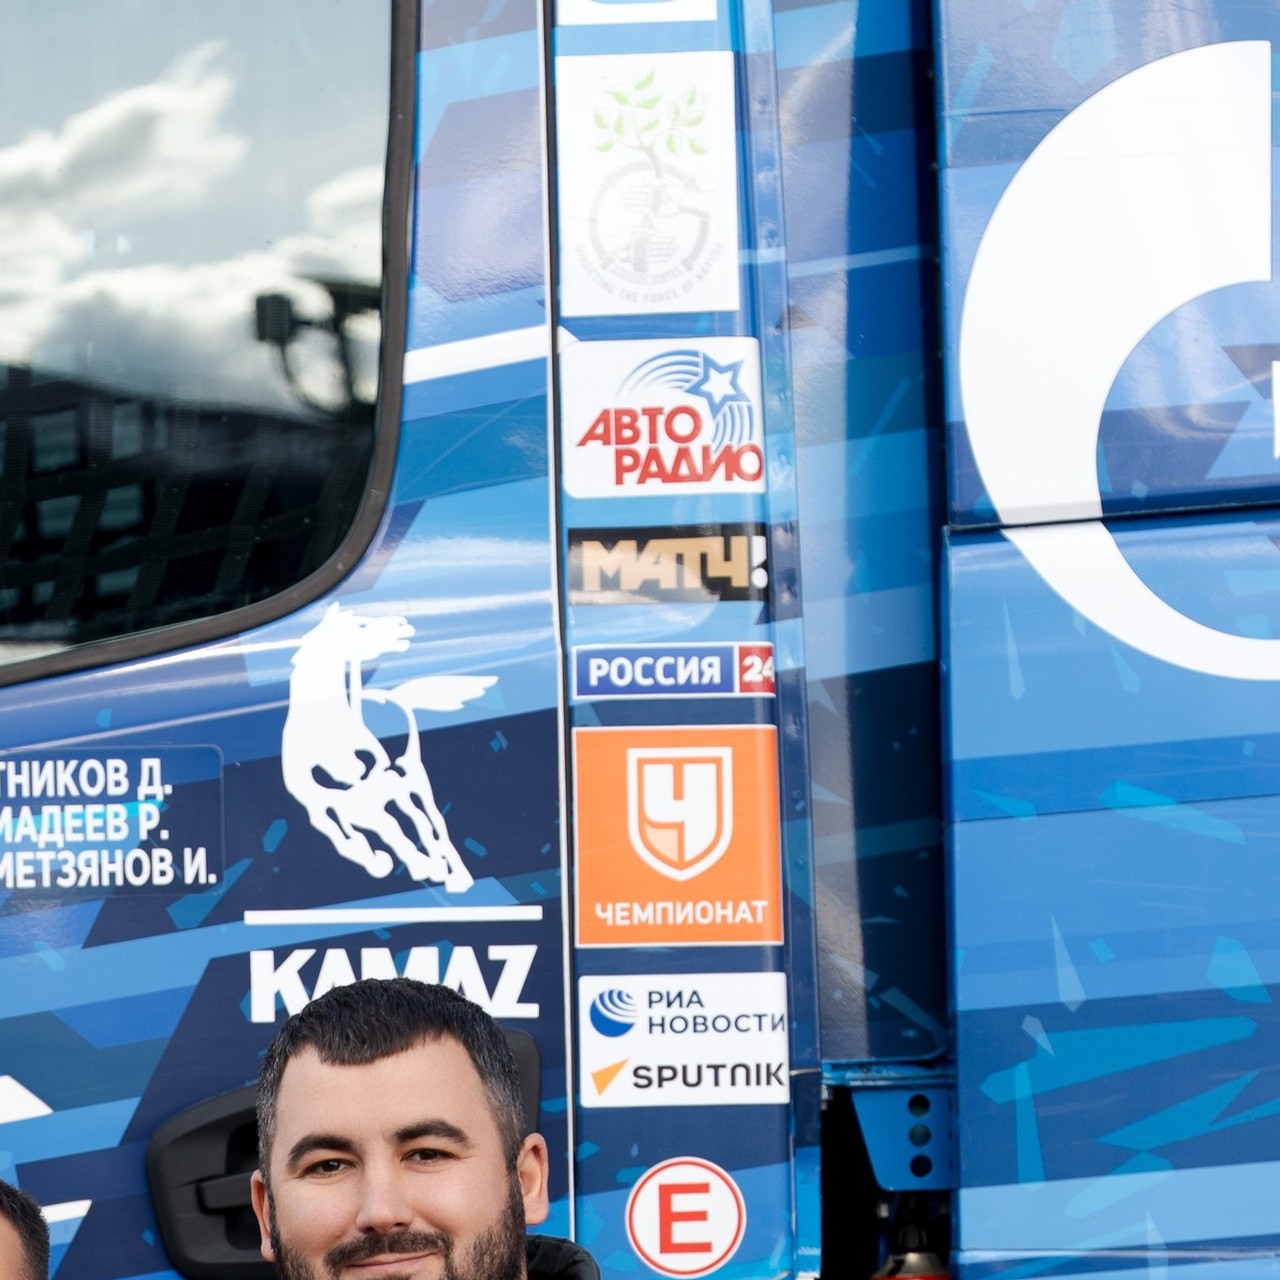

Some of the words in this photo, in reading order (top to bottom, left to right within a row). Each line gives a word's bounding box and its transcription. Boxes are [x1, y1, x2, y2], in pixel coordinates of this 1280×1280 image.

[643, 289, 679, 304] FORCE
[576, 405, 703, 447] АВТО
[615, 443, 764, 486] РАДИО
[589, 655, 721, 687] РОССИЯ
[742, 654, 775, 684] 24
[137, 757, 173, 801] Д.
[138, 803, 170, 841] Р.
[183, 847, 218, 885] И.
[595, 900, 768, 927] ЧЕМПИОНАТ
[648, 990, 705, 1009] РИА
[648, 1013, 785, 1034] НОВОСТИ
[632, 1062, 785, 1089] SPUTNIK
[657, 1182, 712, 1254] E
